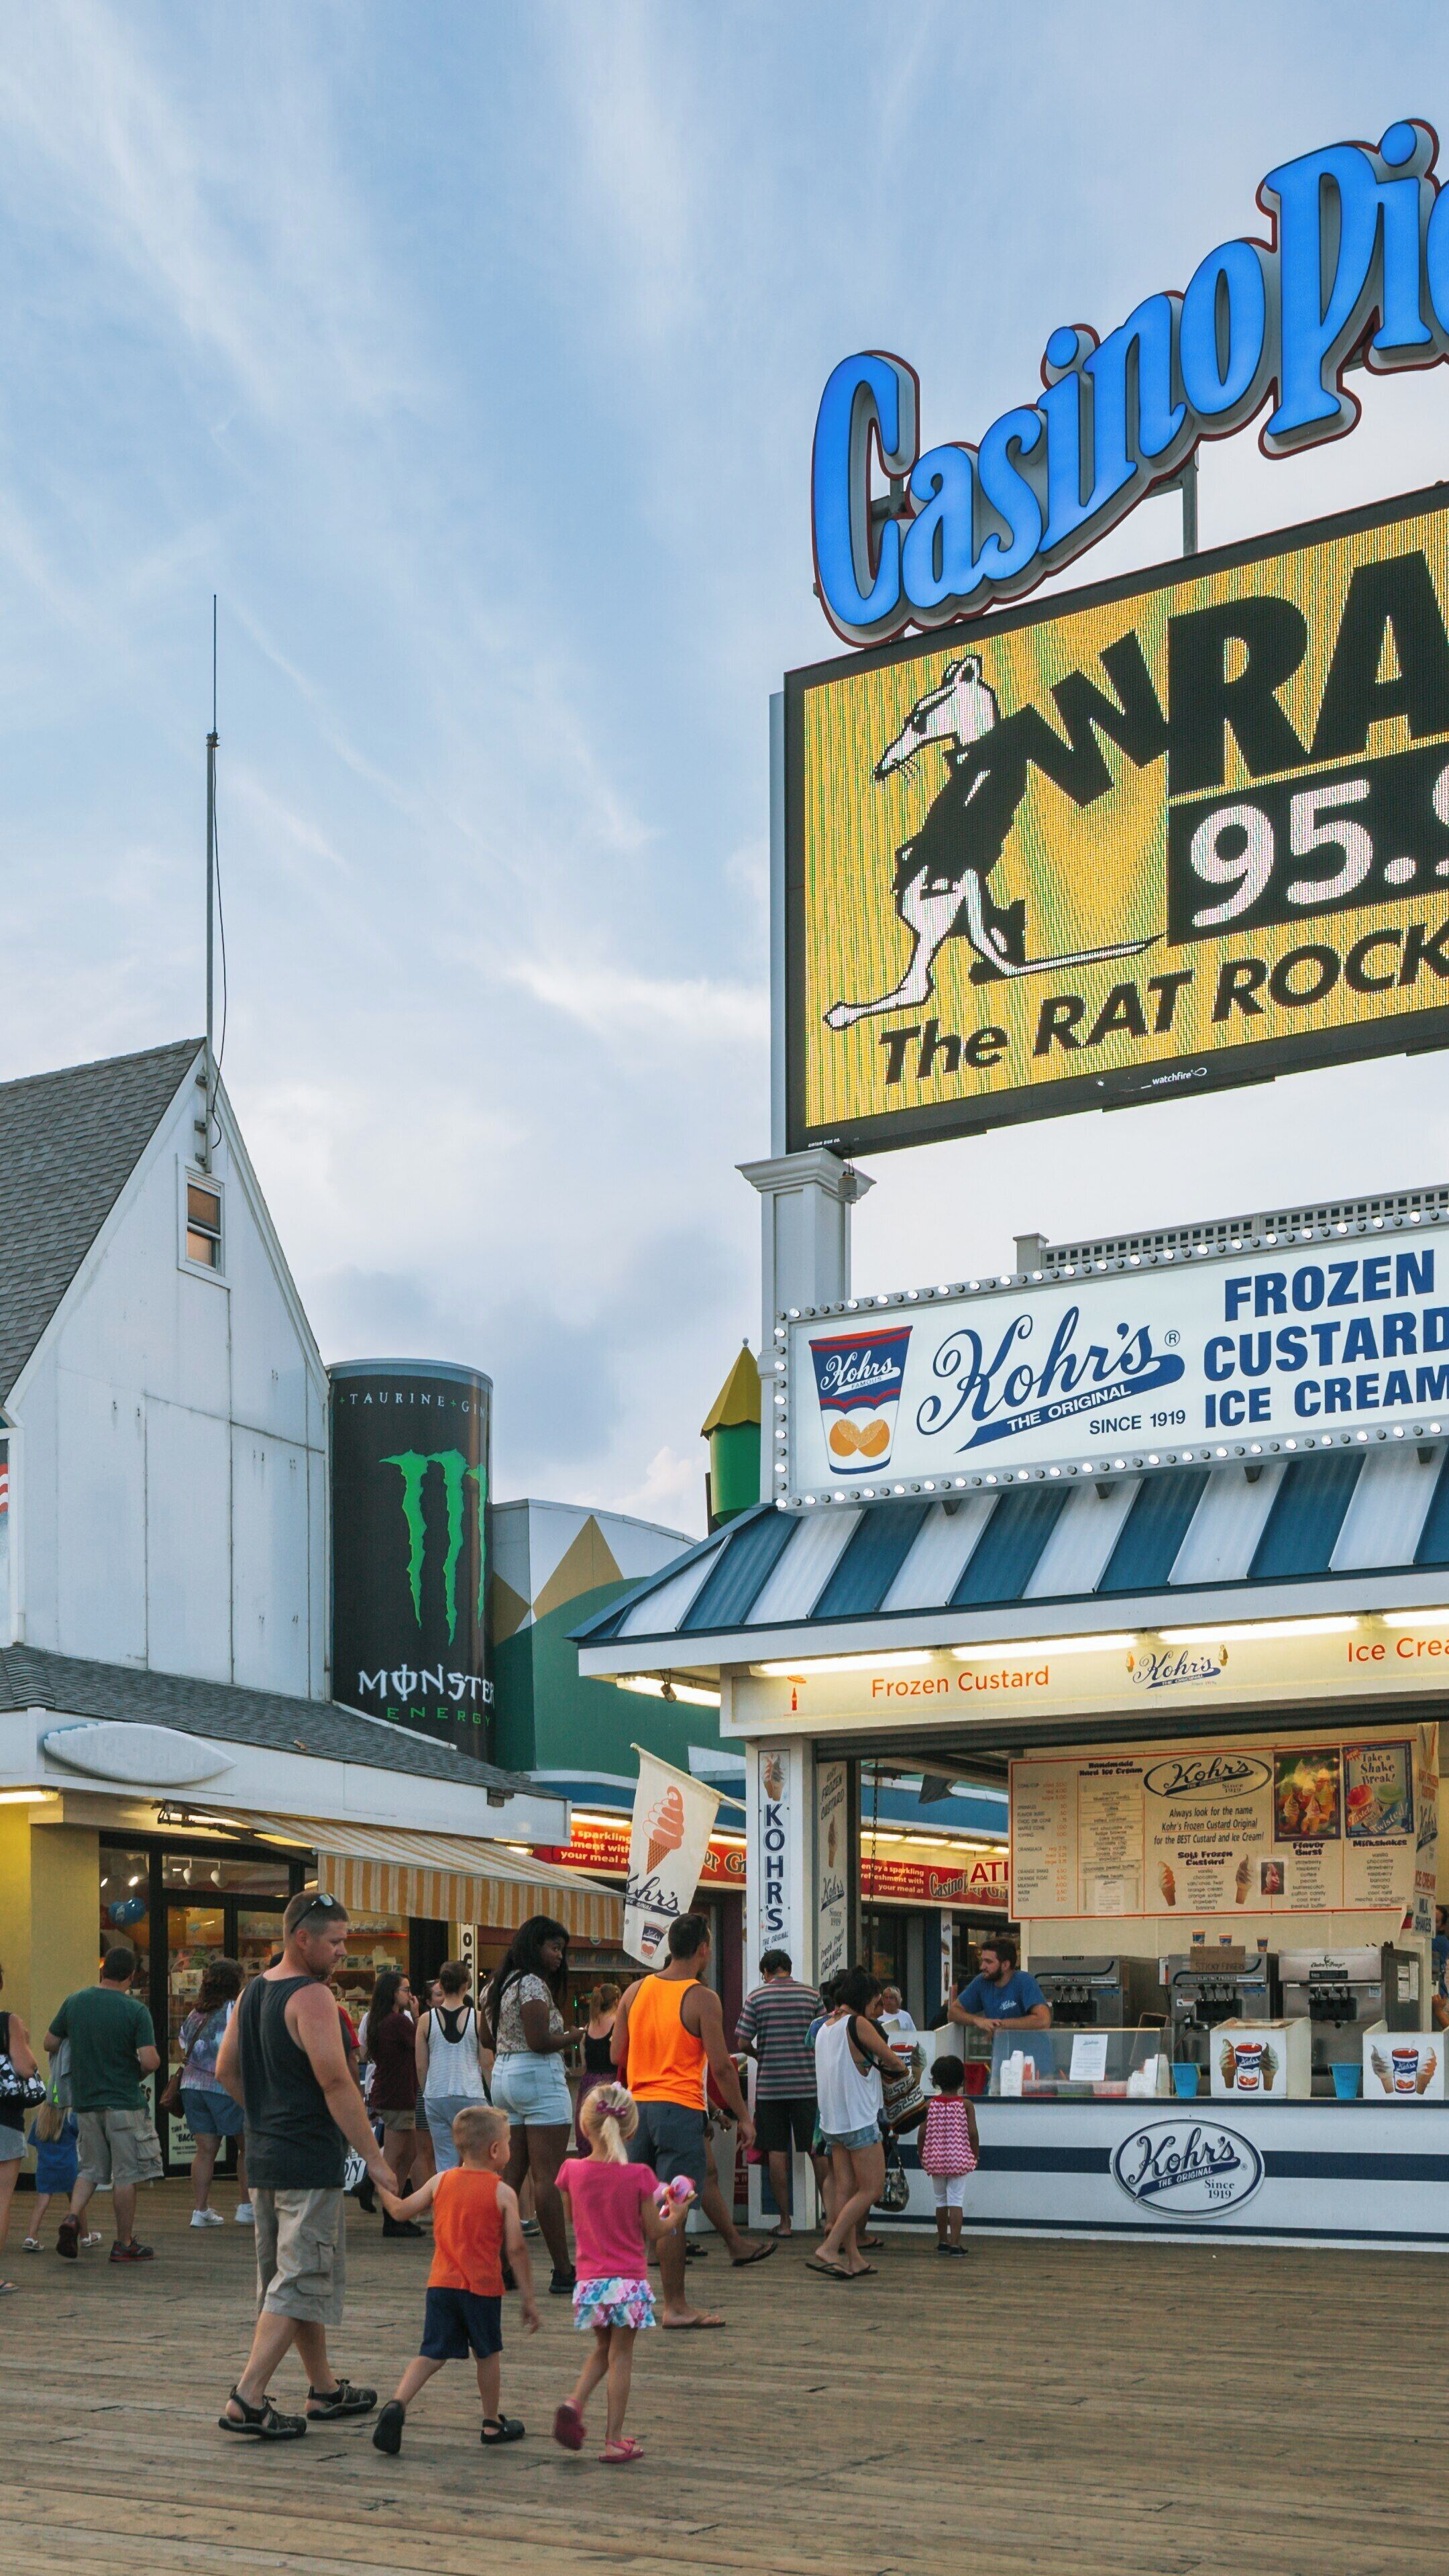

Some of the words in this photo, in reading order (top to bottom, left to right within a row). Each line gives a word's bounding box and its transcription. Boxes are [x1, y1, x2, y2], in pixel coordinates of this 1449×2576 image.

[1189, 748, 1449, 928] 95.
[879, 1018, 1009, 1085] The
[1033, 971, 1192, 1057] RAT
[1212, 920, 1449, 1022] ROCK
[1152, 1070, 1192, 1087] watchfire
[1225, 1249, 1434, 1322] FROZEN
[1203, 1306, 1449, 1382] CUSTARD
[916, 1306, 1155, 1436] Kohr's
[851, 1376, 883, 1389] FAMOUS
[350, 1391, 445, 1407] TAURINE
[1205, 1387, 1271, 1429] ICE
[1294, 1364, 1449, 1417] CREAM
[1006, 1411, 1042, 1432] THE
[1047, 1383, 1132, 1419] ORIGINAL
[1089, 1415, 1142, 1435] SINCE
[1149, 1409, 1186, 1428] 1919
[1348, 1642, 1386, 1662] Ice
[1132, 1650, 1212, 1684] Kohr's
[358, 1663, 495, 1709] MONSTER
[872, 1678, 949, 1698] Frozen
[957, 1665, 1049, 1691] Custard
[387, 1707, 490, 1727] ENERGY
[1362, 1753, 1383, 1762] Take
[1163, 1757, 1250, 1789] Kohr's
[1360, 1761, 1395, 1774] Shake
[1362, 1773, 1395, 1784] Break!
[1169, 1809, 1192, 1819] Always
[1194, 1808, 1208, 1817] look
[1210, 1807, 1220, 1816] for
[1222, 1806, 1233, 1815] the
[1161, 1822, 1182, 1831] Kohr's
[1183, 1821, 1205, 1830] Frozen
[1207, 1819, 1231, 1829] Custard
[1233, 1818, 1258, 1831] Original
[578, 1829, 632, 1844] sparkling
[1154, 1835, 1163, 1845] for
[1165, 1835, 1175, 1844] the
[1177, 1835, 1191, 1844] BEST
[1193, 1833, 1217, 1843] Custard
[1218, 1833, 1230, 1842] and
[1231, 1833, 1240, 1841] Ice
[1242, 1831, 1265, 1841] Cream!
[1352, 1839, 1407, 1847] Milkshakes
[1293, 1841, 1325, 1849] Flavor
[561, 1850, 587, 1860] your
[590, 1854, 619, 1864] meal
[1177, 1851, 1199, 1860] Soft
[1201, 1850, 1234, 1858] Frozen
[1185, 1858, 1225, 1866] Custard
[889, 1866, 924, 1878] sparkling
[878, 1882, 896, 1892] your
[897, 1884, 916, 1893] meal
[908, 1877, 924, 1885] with
[771, 1931, 789, 1944] ORIGINAL
[1128, 2127, 1236, 2186] Kohr's
[1158, 2176, 1173, 2189] THE
[1175, 2166, 1214, 2183] ORIGINAL
[1204, 2180, 1235, 2190] Since
[1208, 2190, 1232, 2199] 1919
